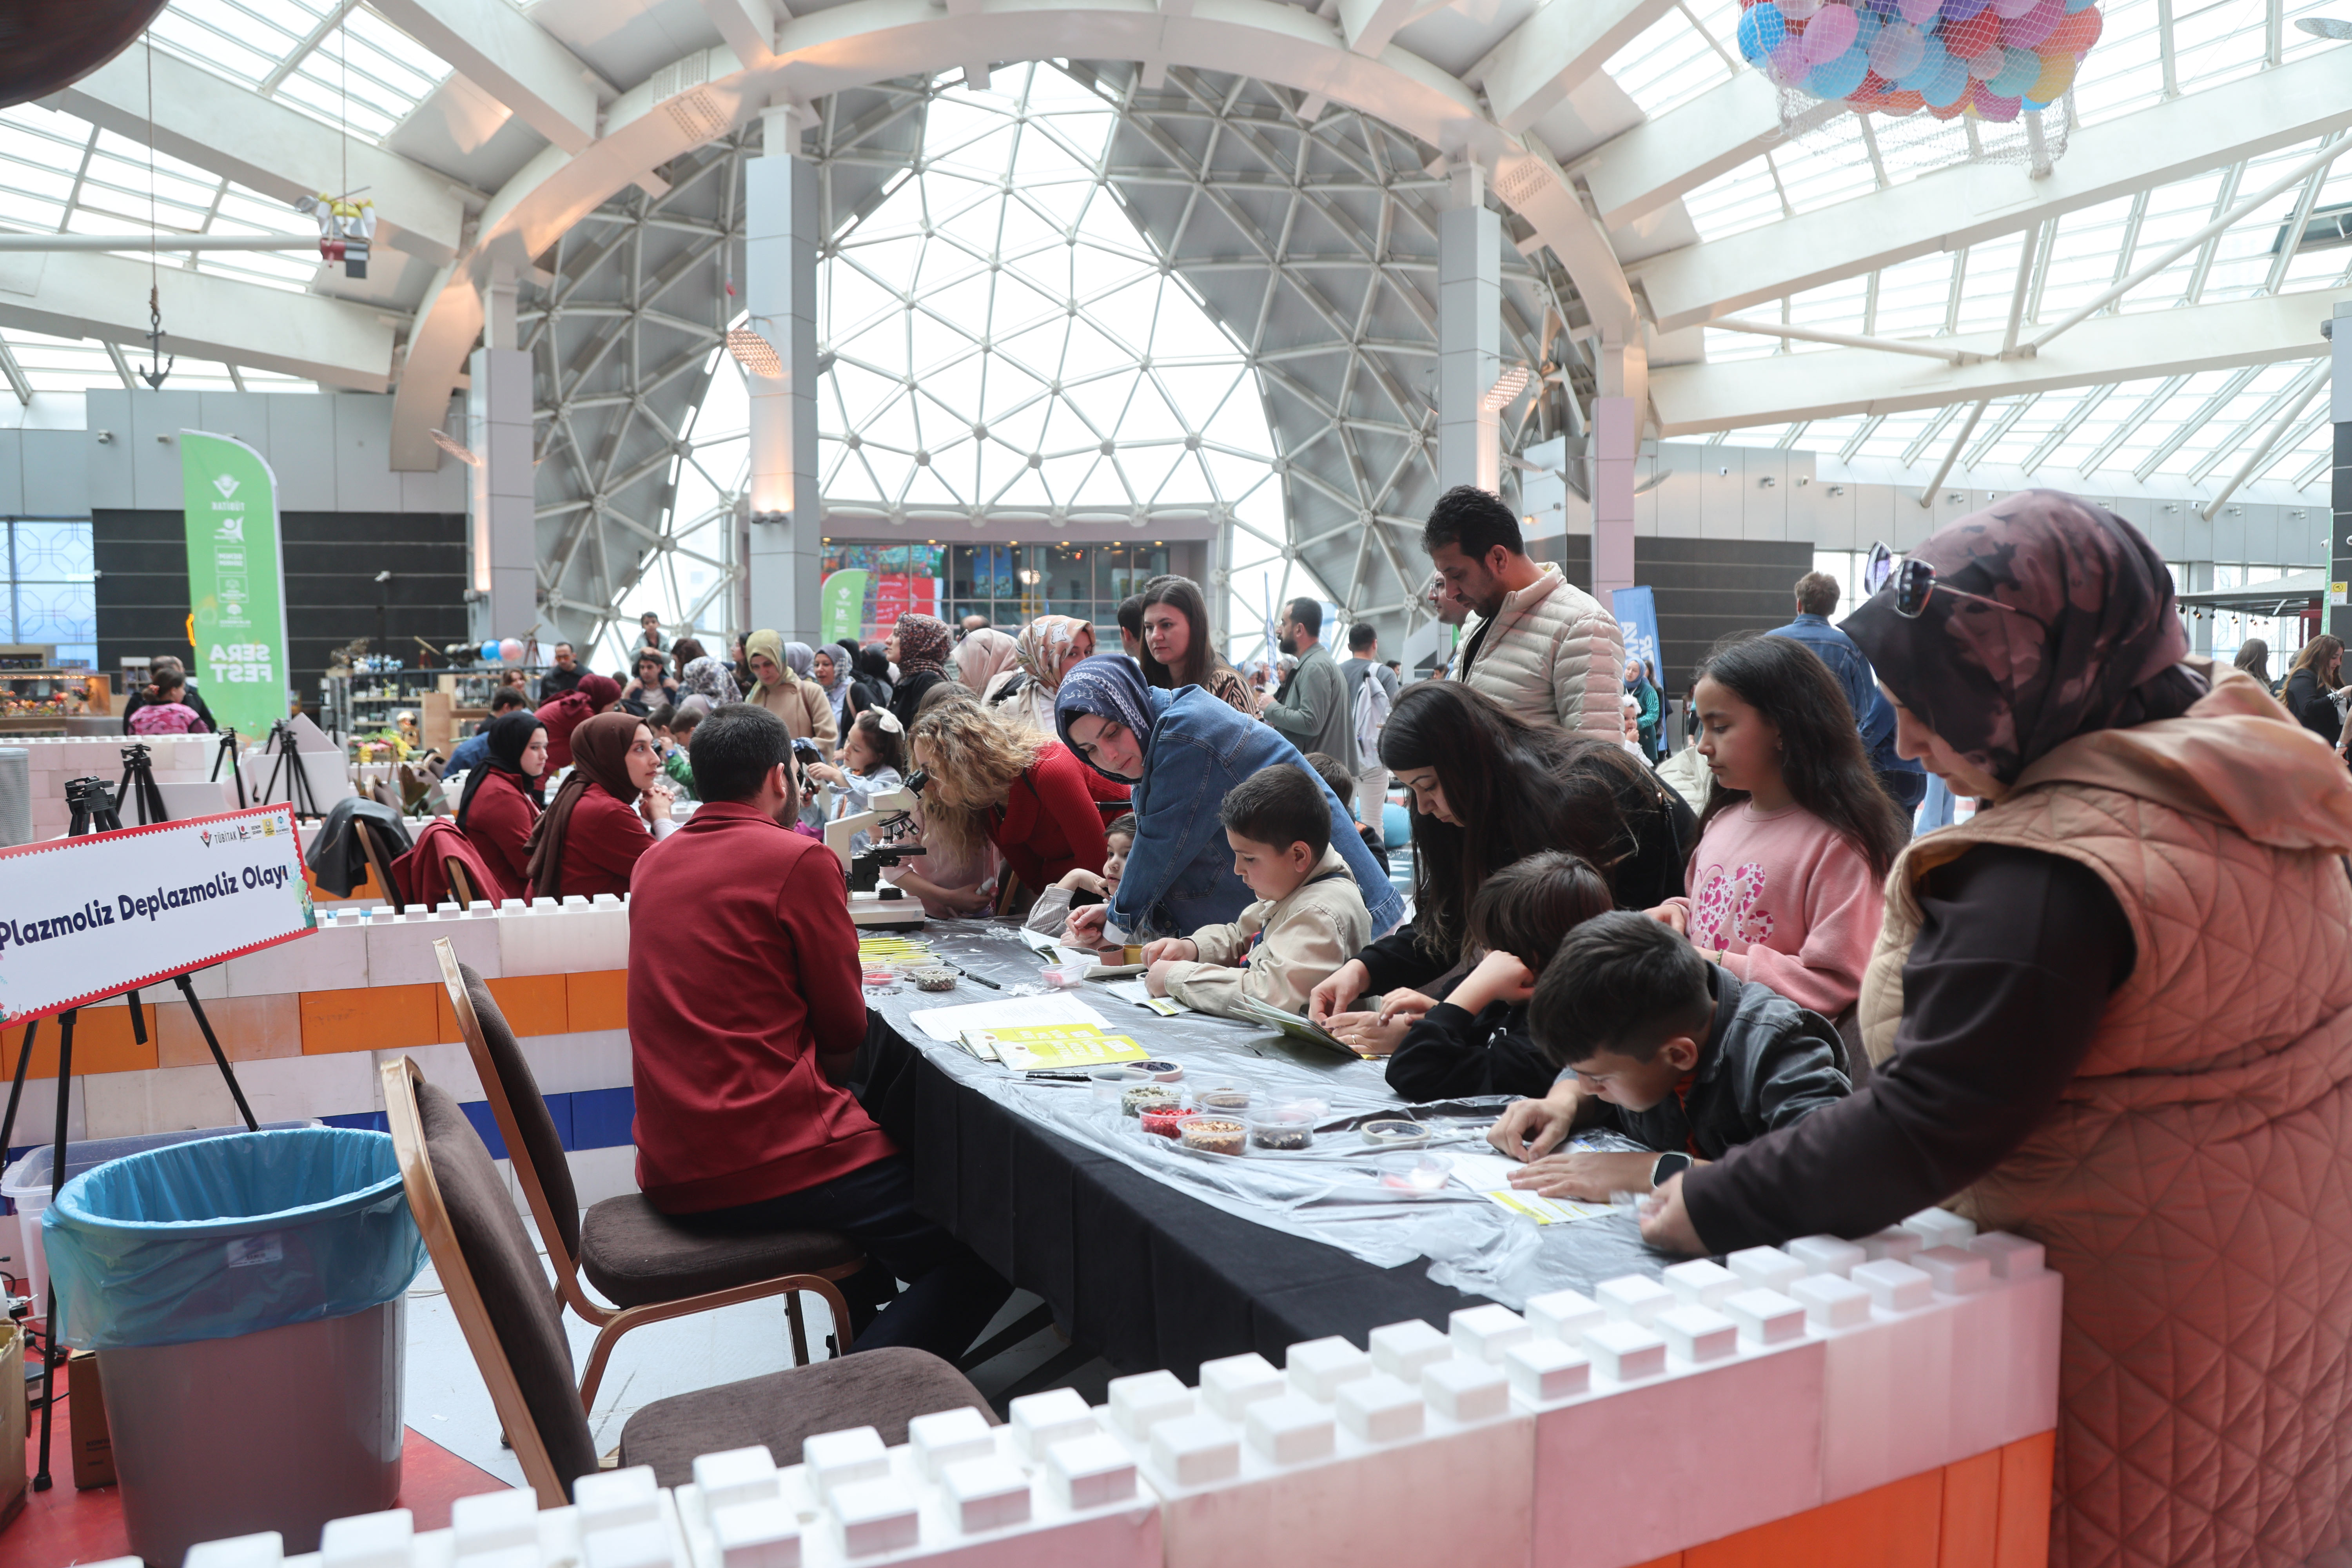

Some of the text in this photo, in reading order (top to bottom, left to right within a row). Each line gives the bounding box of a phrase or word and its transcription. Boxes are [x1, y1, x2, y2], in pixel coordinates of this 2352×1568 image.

[214, 831, 238, 844] TÜBİTAK
[0, 864, 289, 951] Plazmoliz Deplazmoliz Olayı
[1080, 1040, 1105, 1057] TOHUM
